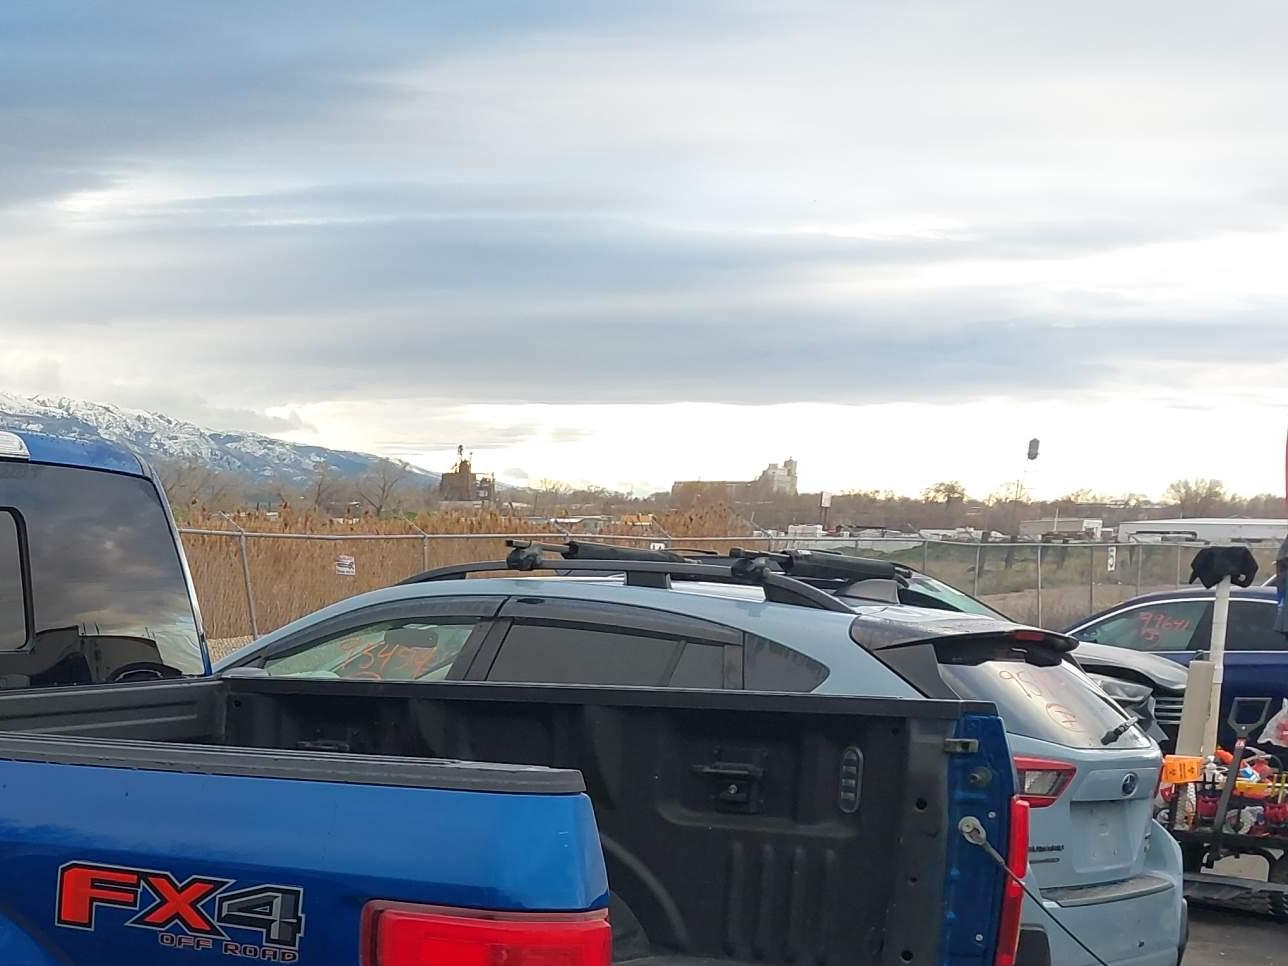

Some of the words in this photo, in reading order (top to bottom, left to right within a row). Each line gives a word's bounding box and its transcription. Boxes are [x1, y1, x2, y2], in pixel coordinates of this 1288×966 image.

[55, 860, 306, 949] FX4
[158, 931, 213, 951] OFF
[222, 941, 299, 964] ROAD
